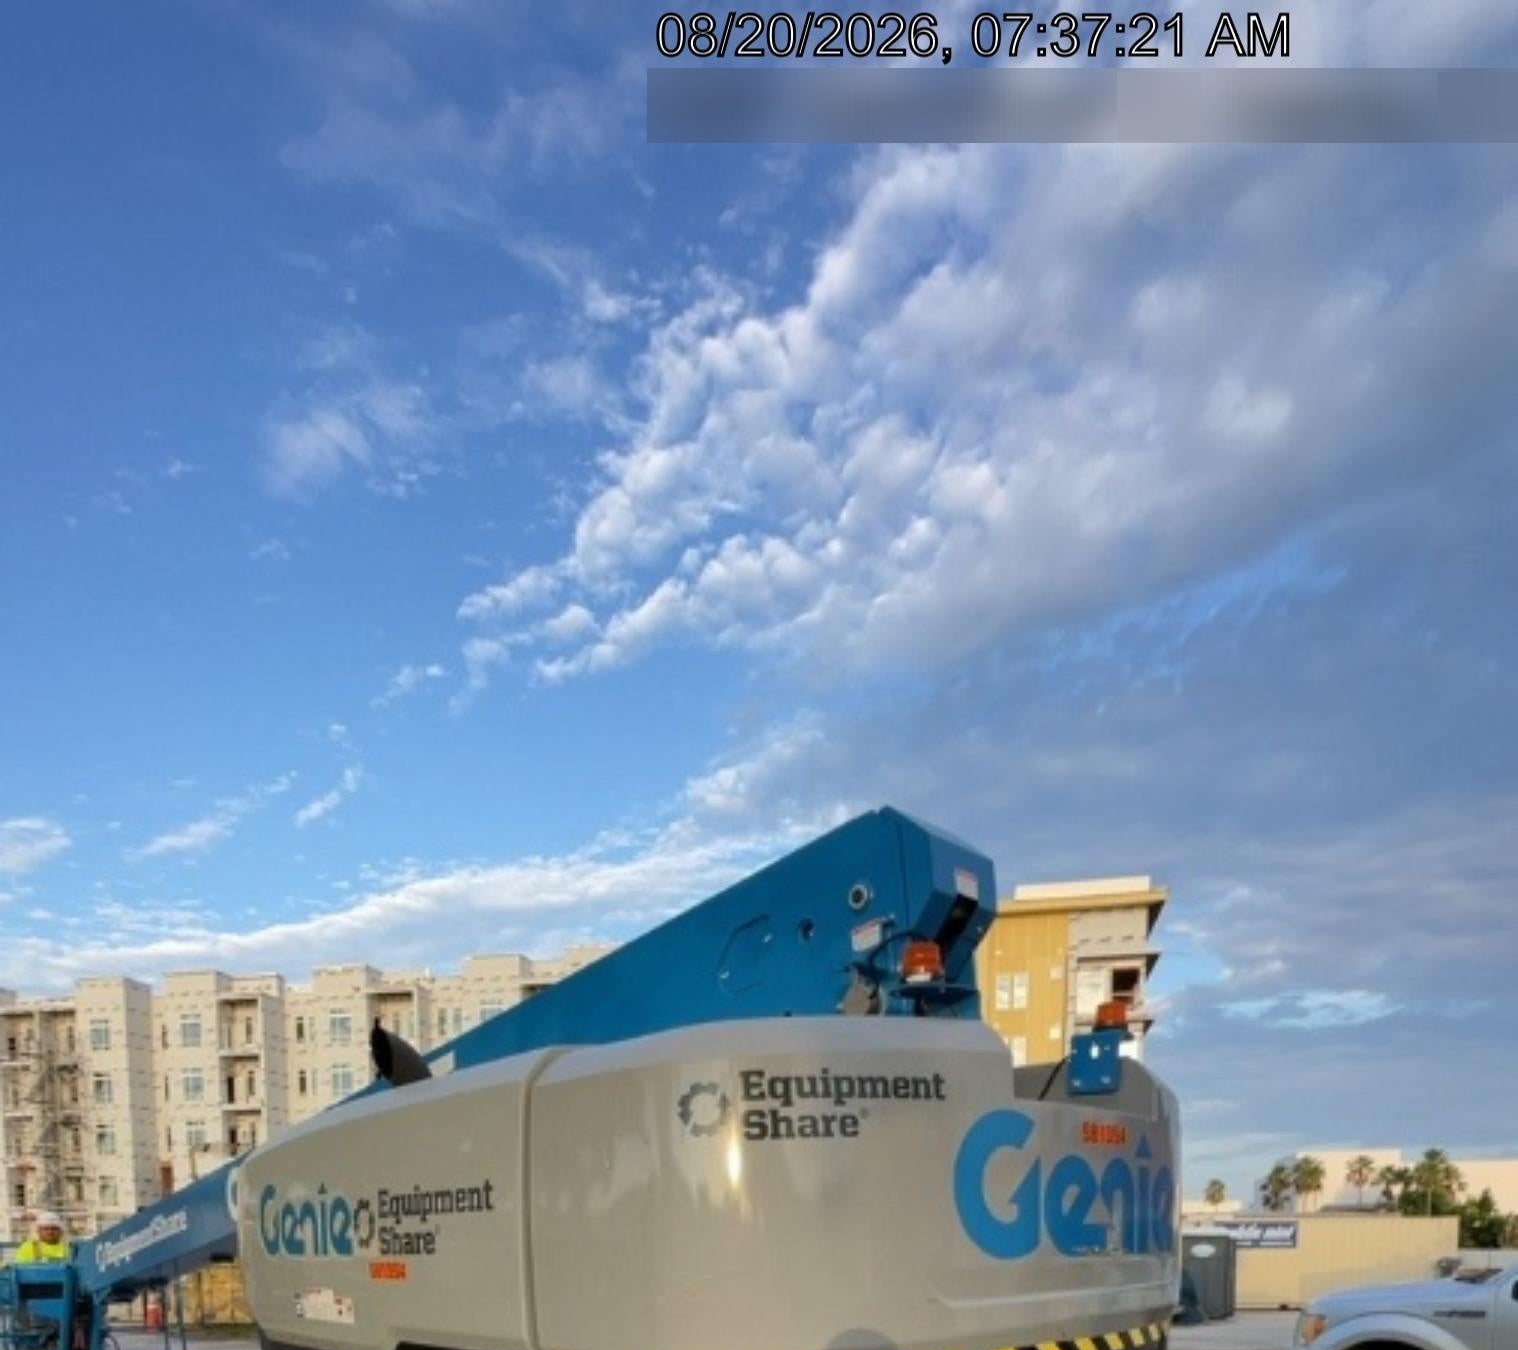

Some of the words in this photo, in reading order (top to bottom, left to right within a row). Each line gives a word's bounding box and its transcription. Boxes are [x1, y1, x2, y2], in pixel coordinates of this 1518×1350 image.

[739, 1067, 947, 1108] Equipment
[743, 1108, 860, 1141] Share
[377, 1178, 494, 1225] Equipment
[953, 1107, 1175, 1260] Genie
[260, 1182, 354, 1257] Genie
[378, 1225, 437, 1256] Share
